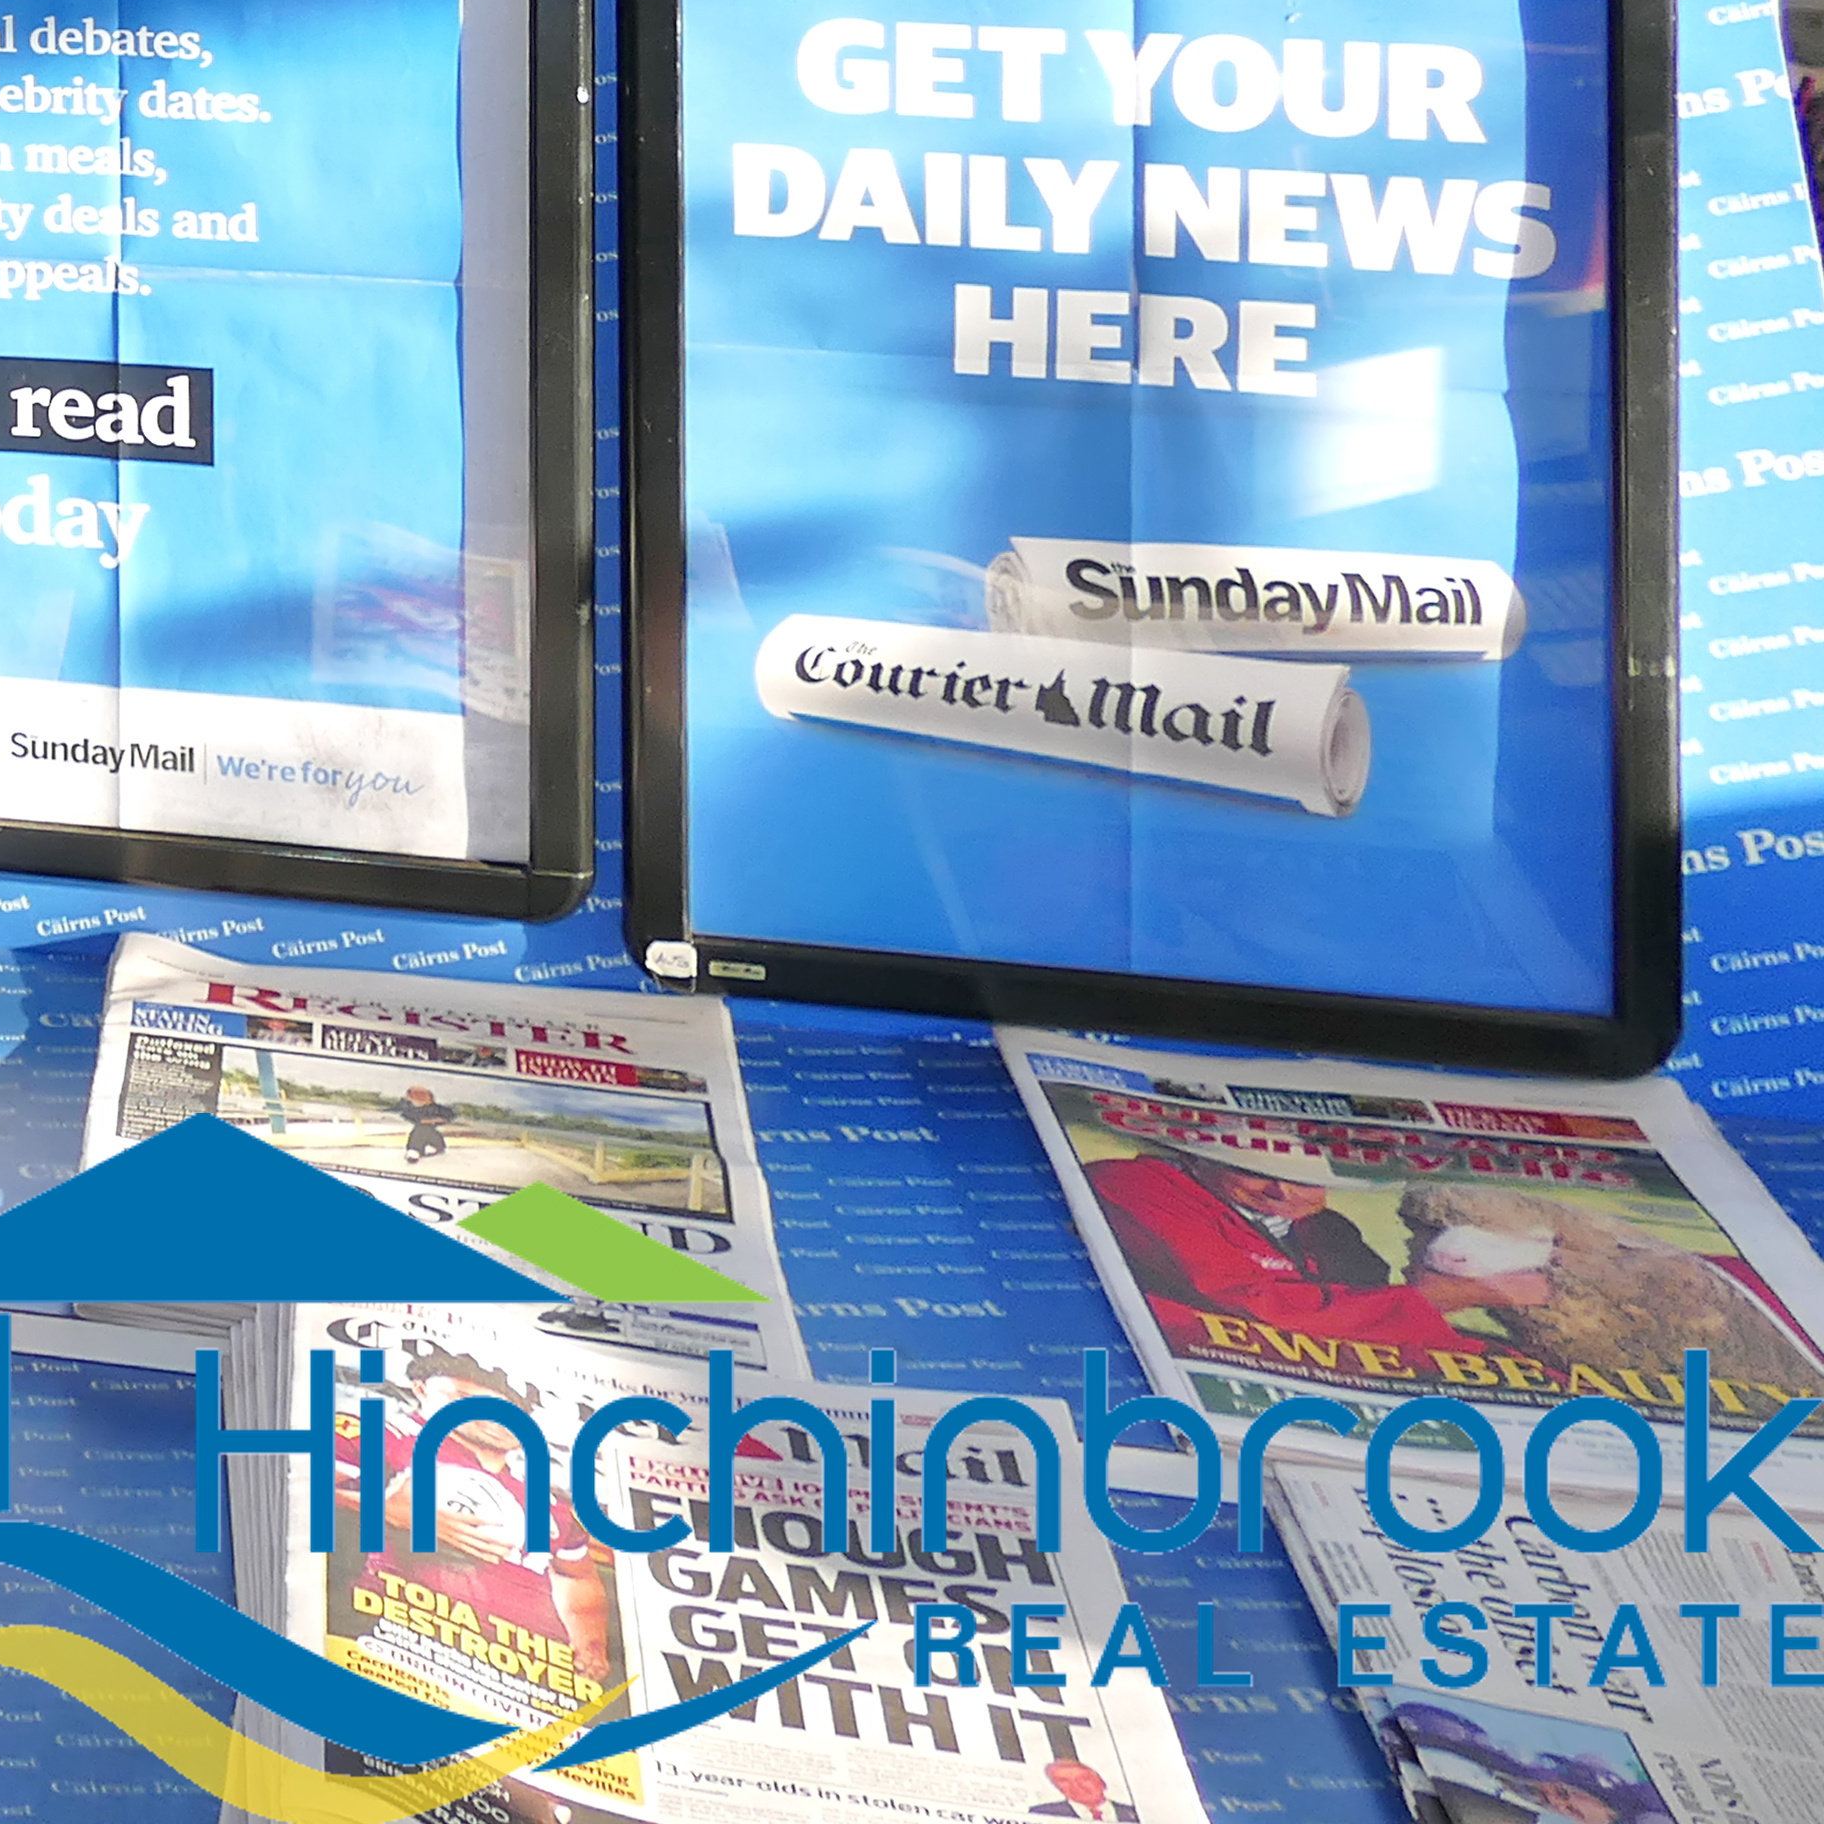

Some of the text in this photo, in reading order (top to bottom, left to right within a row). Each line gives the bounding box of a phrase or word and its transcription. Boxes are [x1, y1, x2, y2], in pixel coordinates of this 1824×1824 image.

[29, 16, 215, 69] debates,
[138, 80, 272, 125] dates.
[795, 16, 1488, 145] GET YOUR
[24, 135, 168, 188] meals,
[42, 195, 161, 240] deals
[172, 203, 259, 244] and
[731, 142, 1558, 280] DAILY NEWS
[952, 282, 1318, 399] HERE
[9, 375, 198, 450] read
[793, 643, 1276, 760] Courier Mail
[343, 764, 427, 806] you
